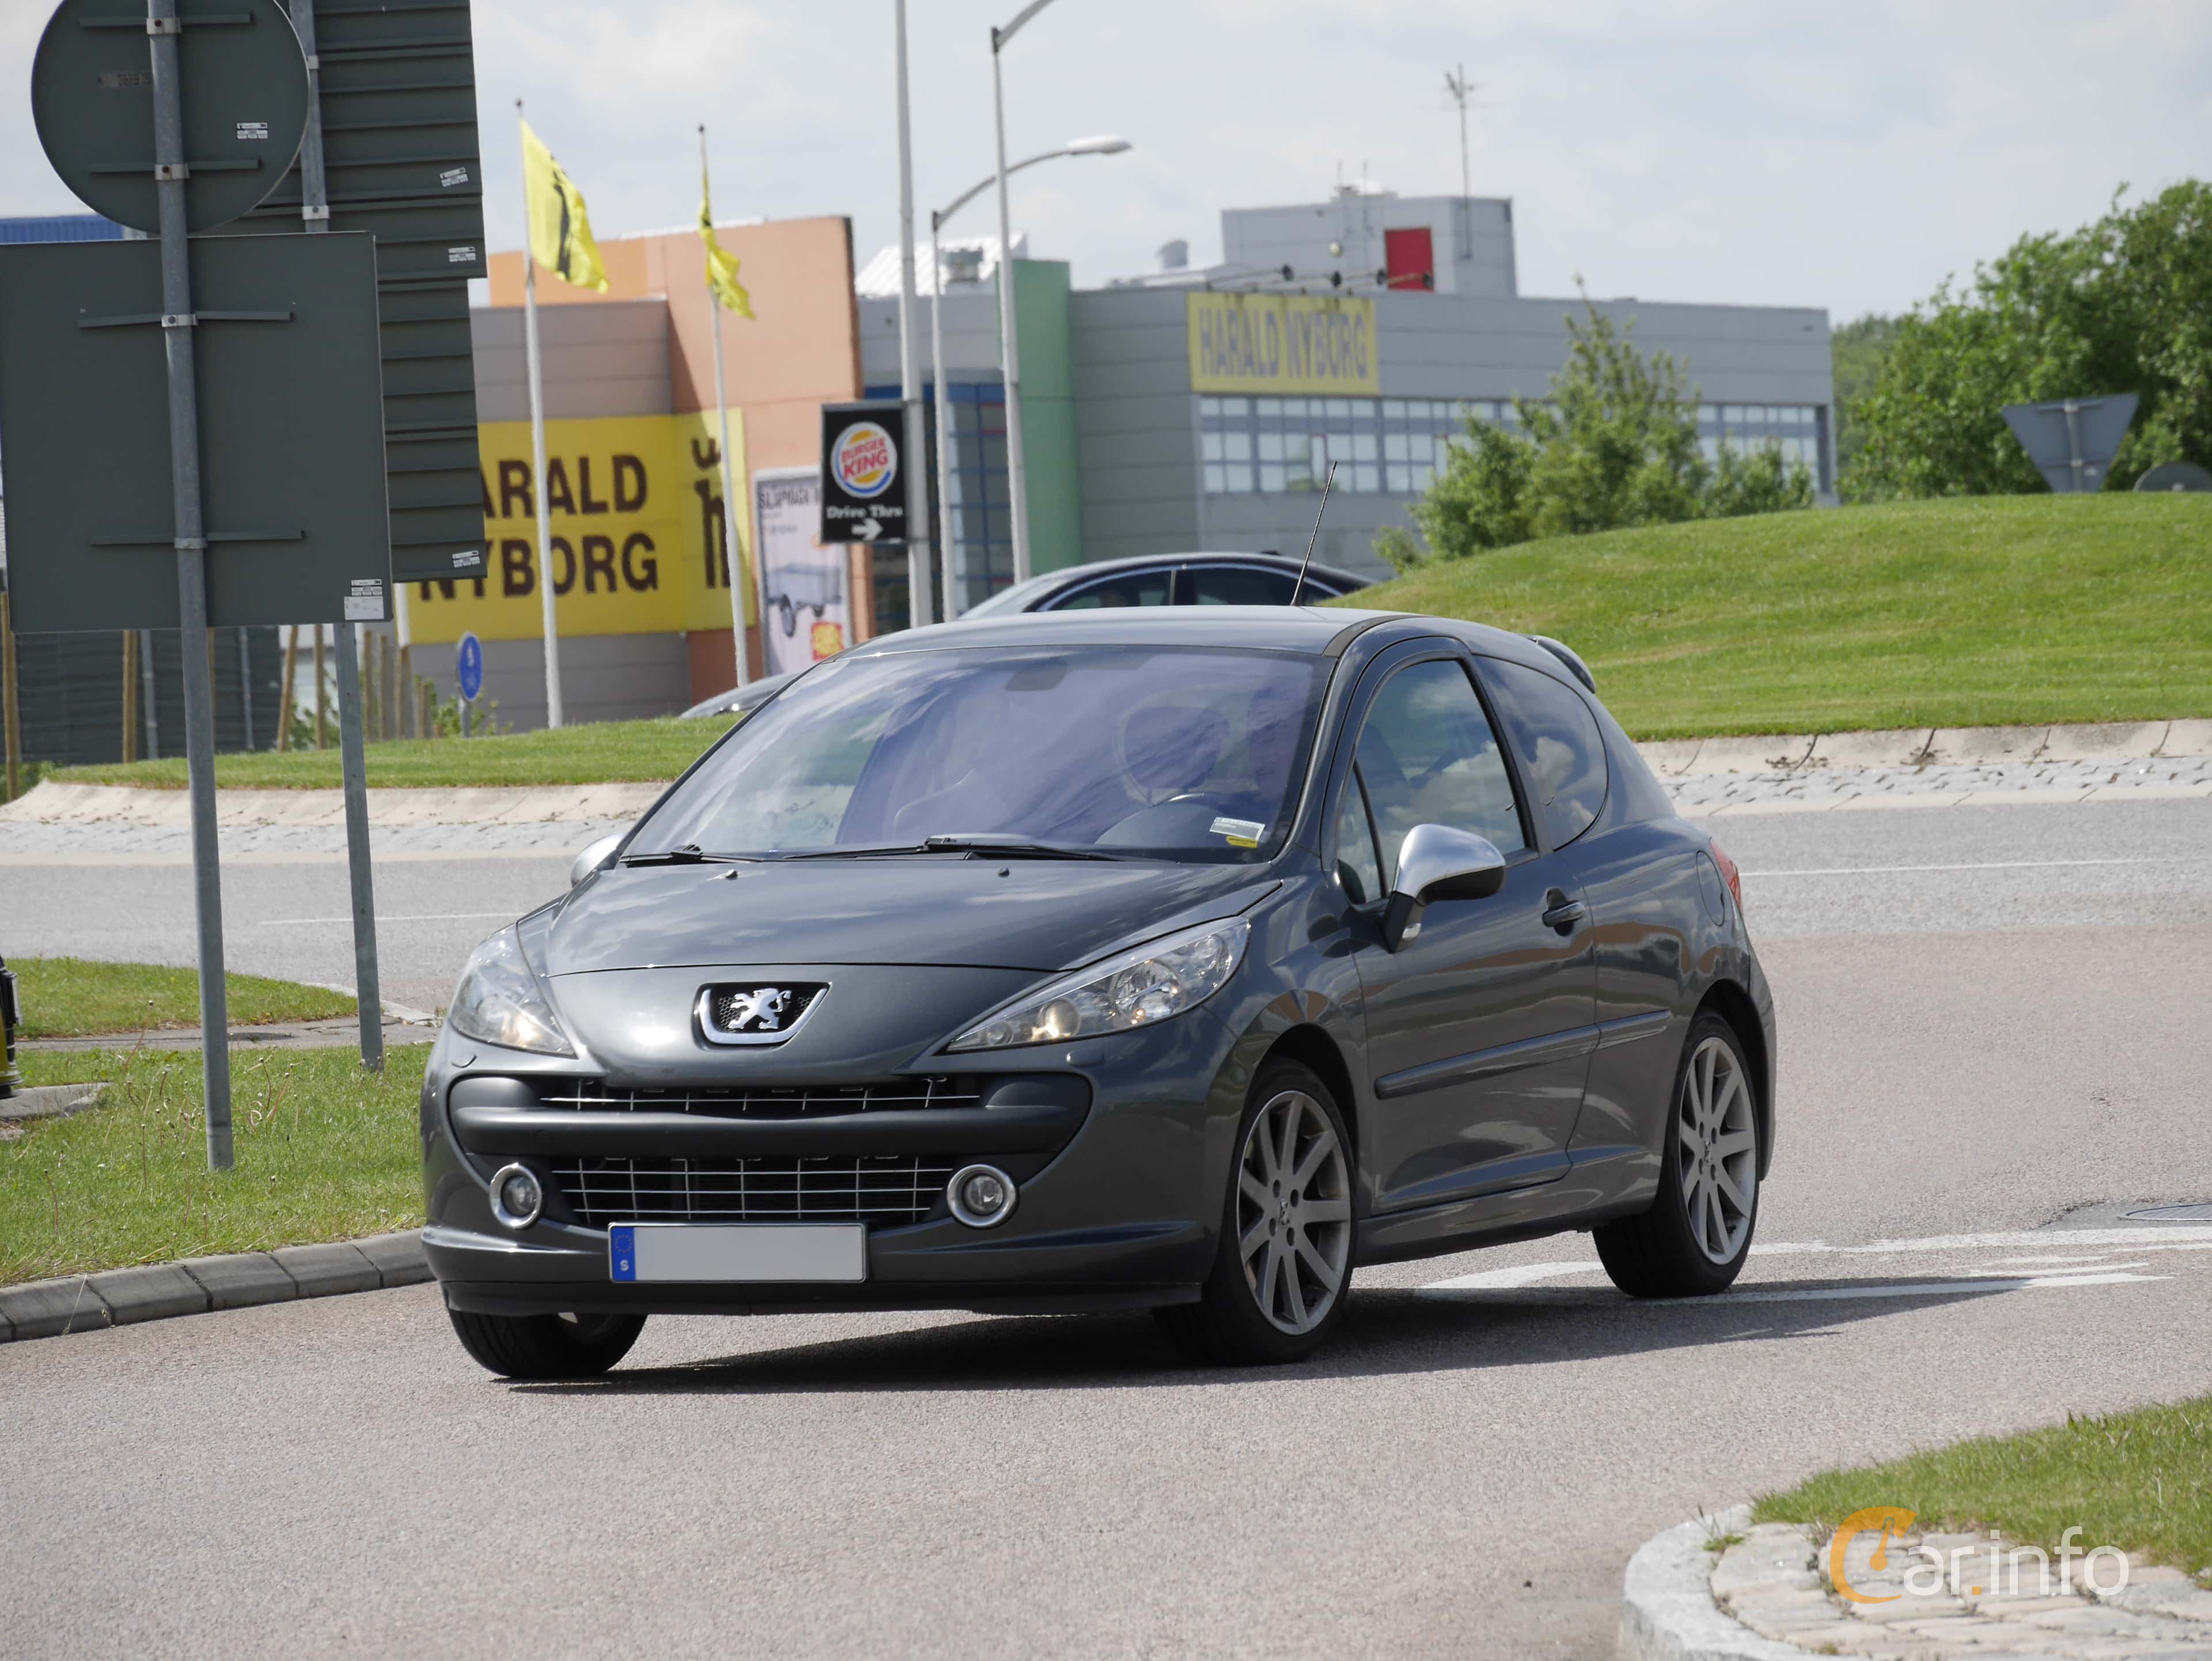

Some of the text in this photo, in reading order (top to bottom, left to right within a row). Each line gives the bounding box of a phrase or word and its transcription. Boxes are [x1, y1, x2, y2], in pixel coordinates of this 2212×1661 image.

[1199, 308, 1369, 380] HARALD NYBORG
[841, 437, 886, 461] BURGER
[843, 448, 888, 480] KING
[826, 504, 904, 519] Drive Thru
[620, 1260, 629, 1272] S
